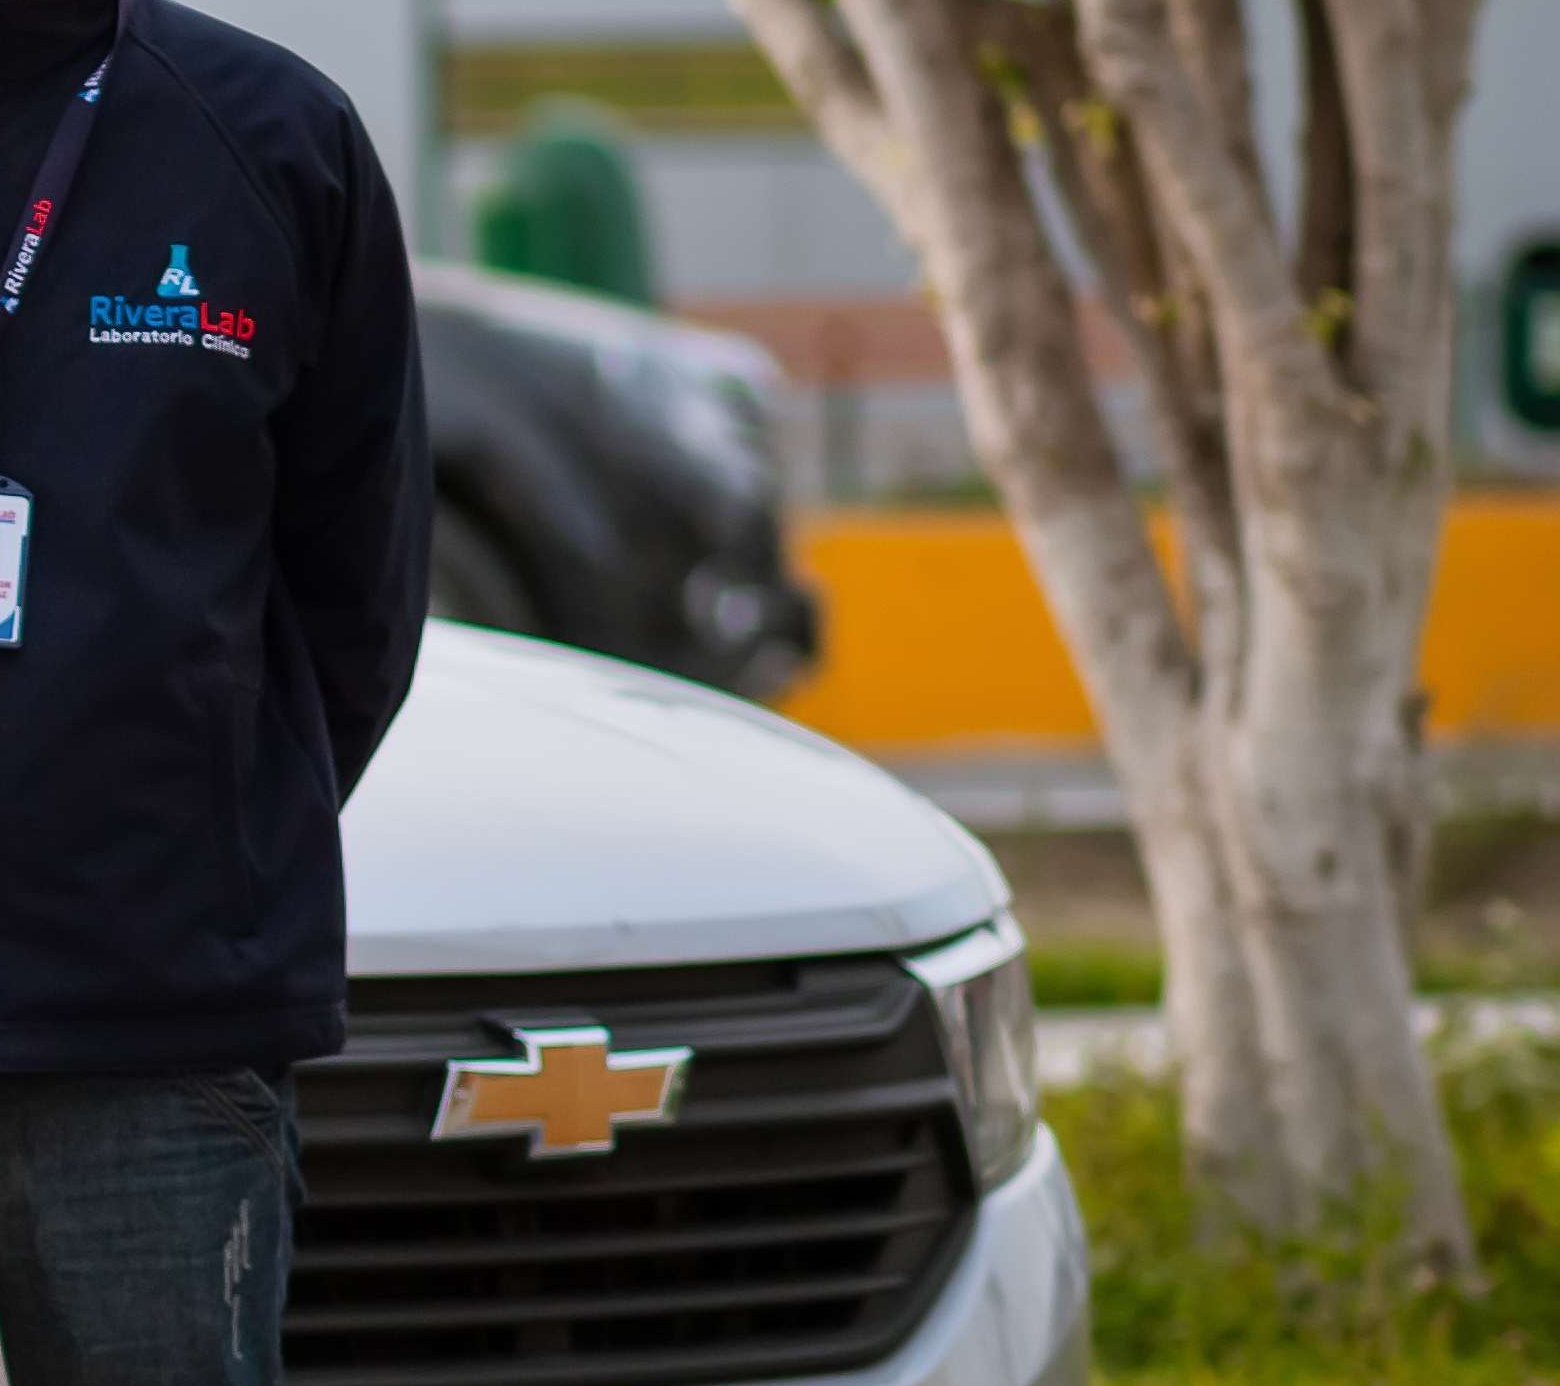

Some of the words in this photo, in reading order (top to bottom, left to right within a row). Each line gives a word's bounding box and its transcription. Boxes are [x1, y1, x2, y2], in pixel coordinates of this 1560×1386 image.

[3, 198, 53, 295] RiveraLab
[89, 295, 256, 341] RiveraLab
[89, 327, 195, 347] Laboratorio
